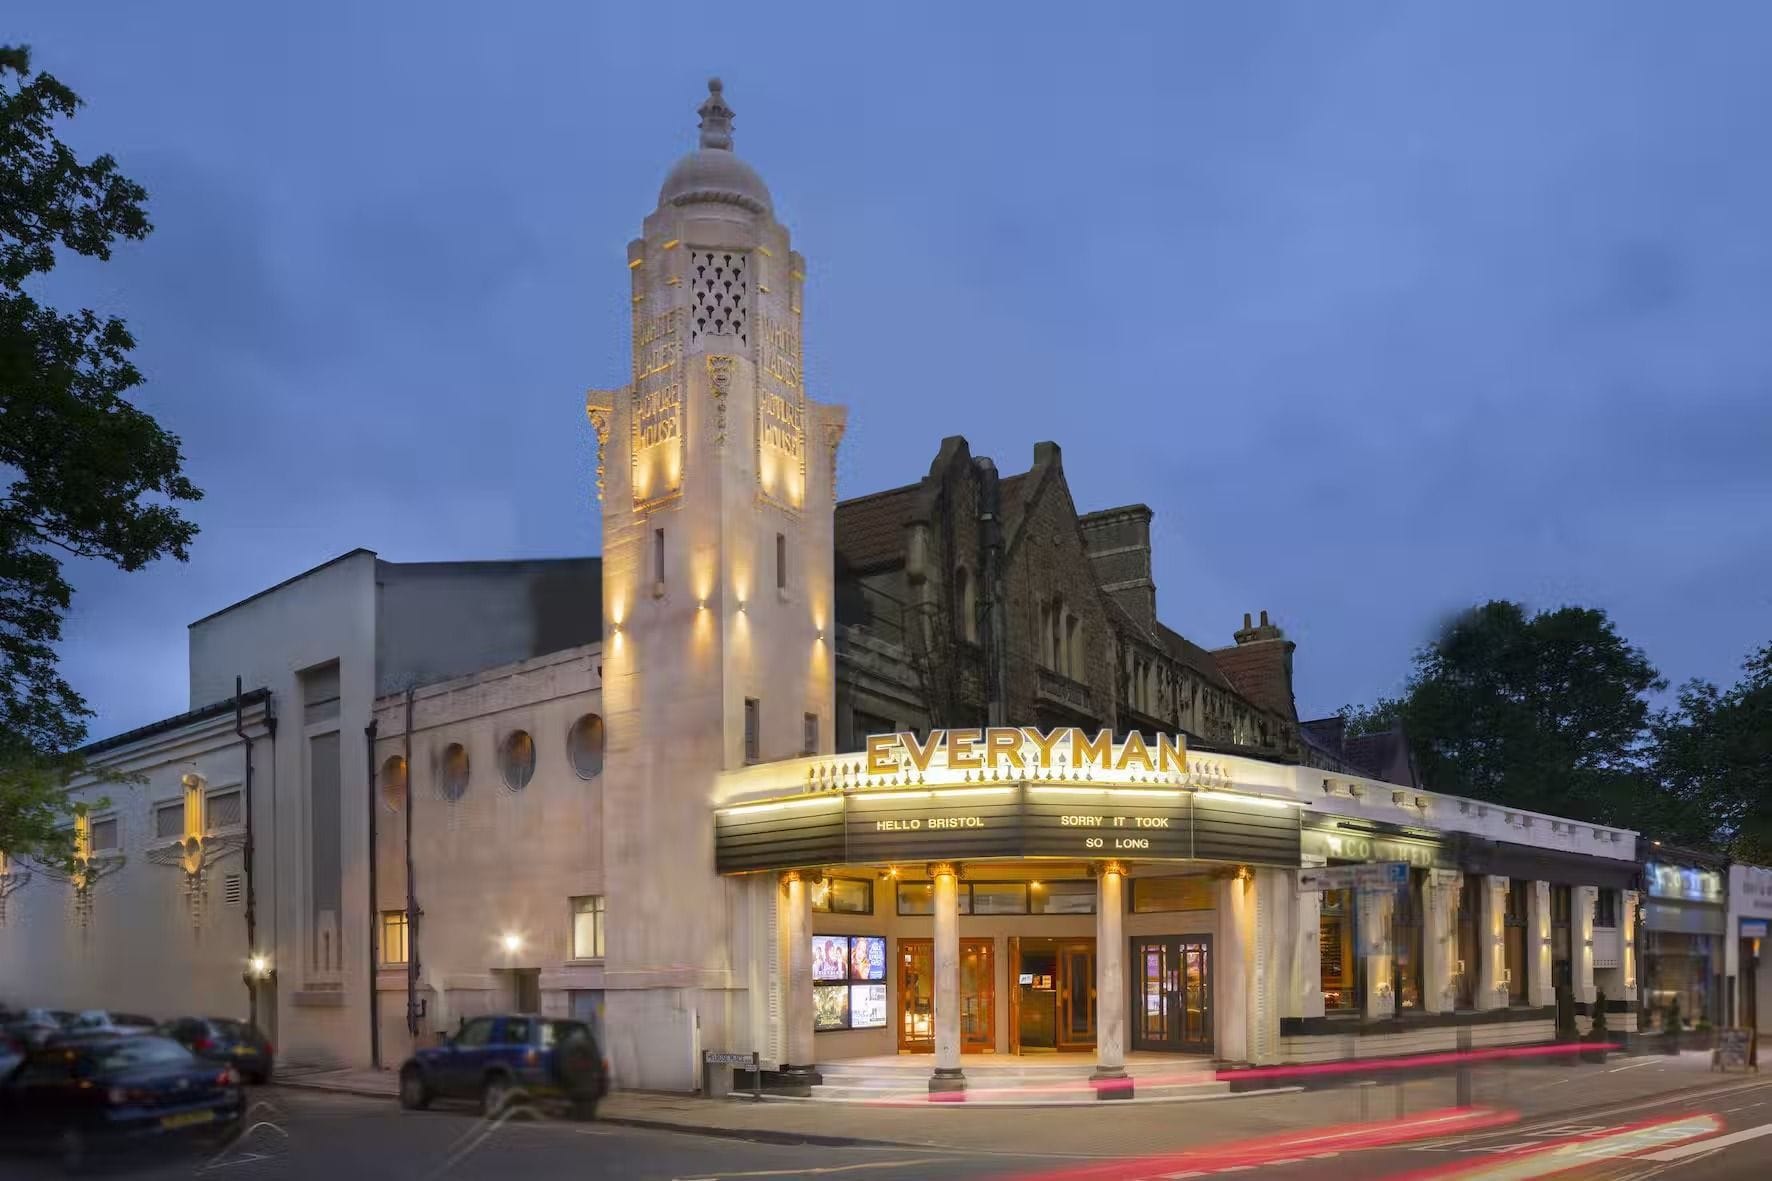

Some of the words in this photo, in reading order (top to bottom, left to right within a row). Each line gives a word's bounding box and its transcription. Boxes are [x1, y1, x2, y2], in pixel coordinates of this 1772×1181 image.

[866, 727, 1187, 775] EVERYMAN
[876, 819, 920, 831] HELLO
[928, 817, 984, 829] BRISTOL
[1061, 816, 1103, 826] SORRY
[1113, 817, 1125, 827] IT
[1135, 817, 1169, 828] TOOK
[1086, 838, 1103, 848] SO
[1115, 839, 1149, 849] LONG
